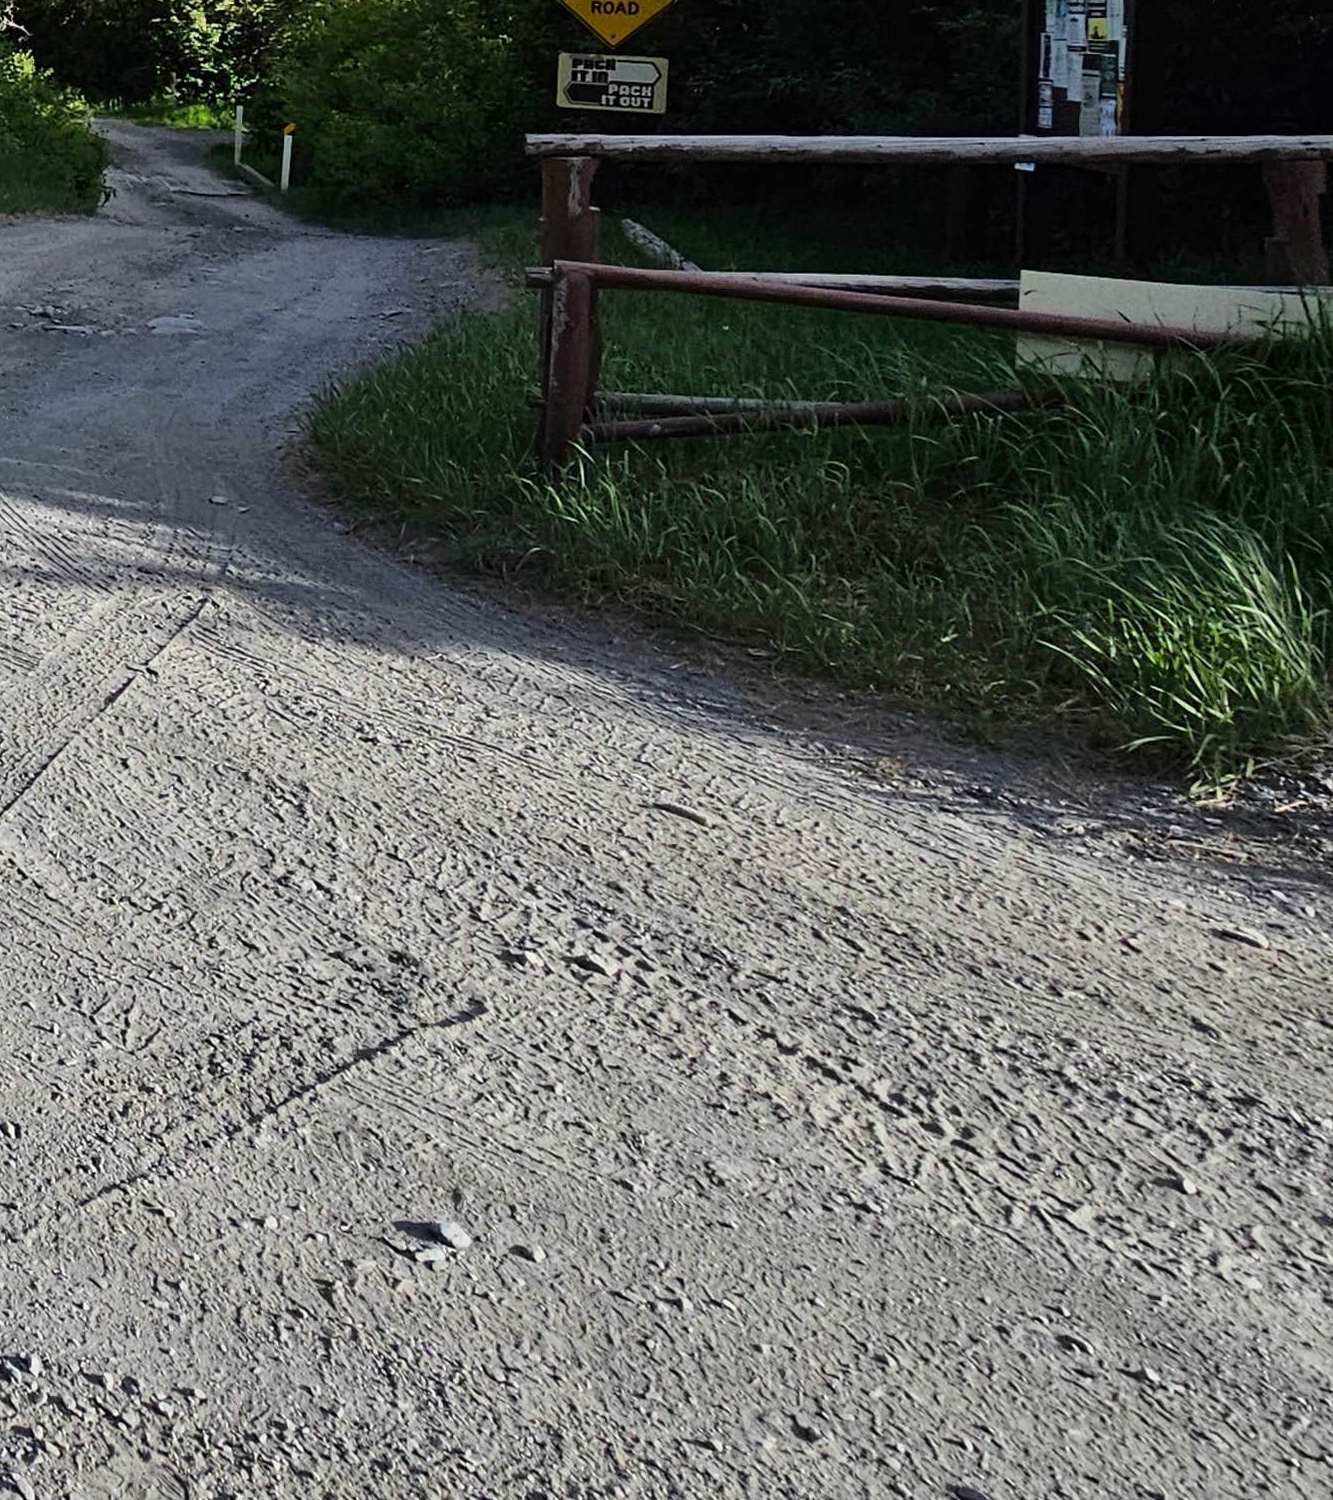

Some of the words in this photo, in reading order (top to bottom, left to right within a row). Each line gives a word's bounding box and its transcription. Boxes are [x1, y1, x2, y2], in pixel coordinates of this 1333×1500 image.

[591, 1, 640, 15] ROAD
[571, 58, 616, 70] PACK
[571, 70, 590, 82] IT
[592, 71, 609, 83] IN
[608, 84, 652, 96] PACK
[601, 95, 616, 105] IT
[619, 96, 652, 108] OUT
